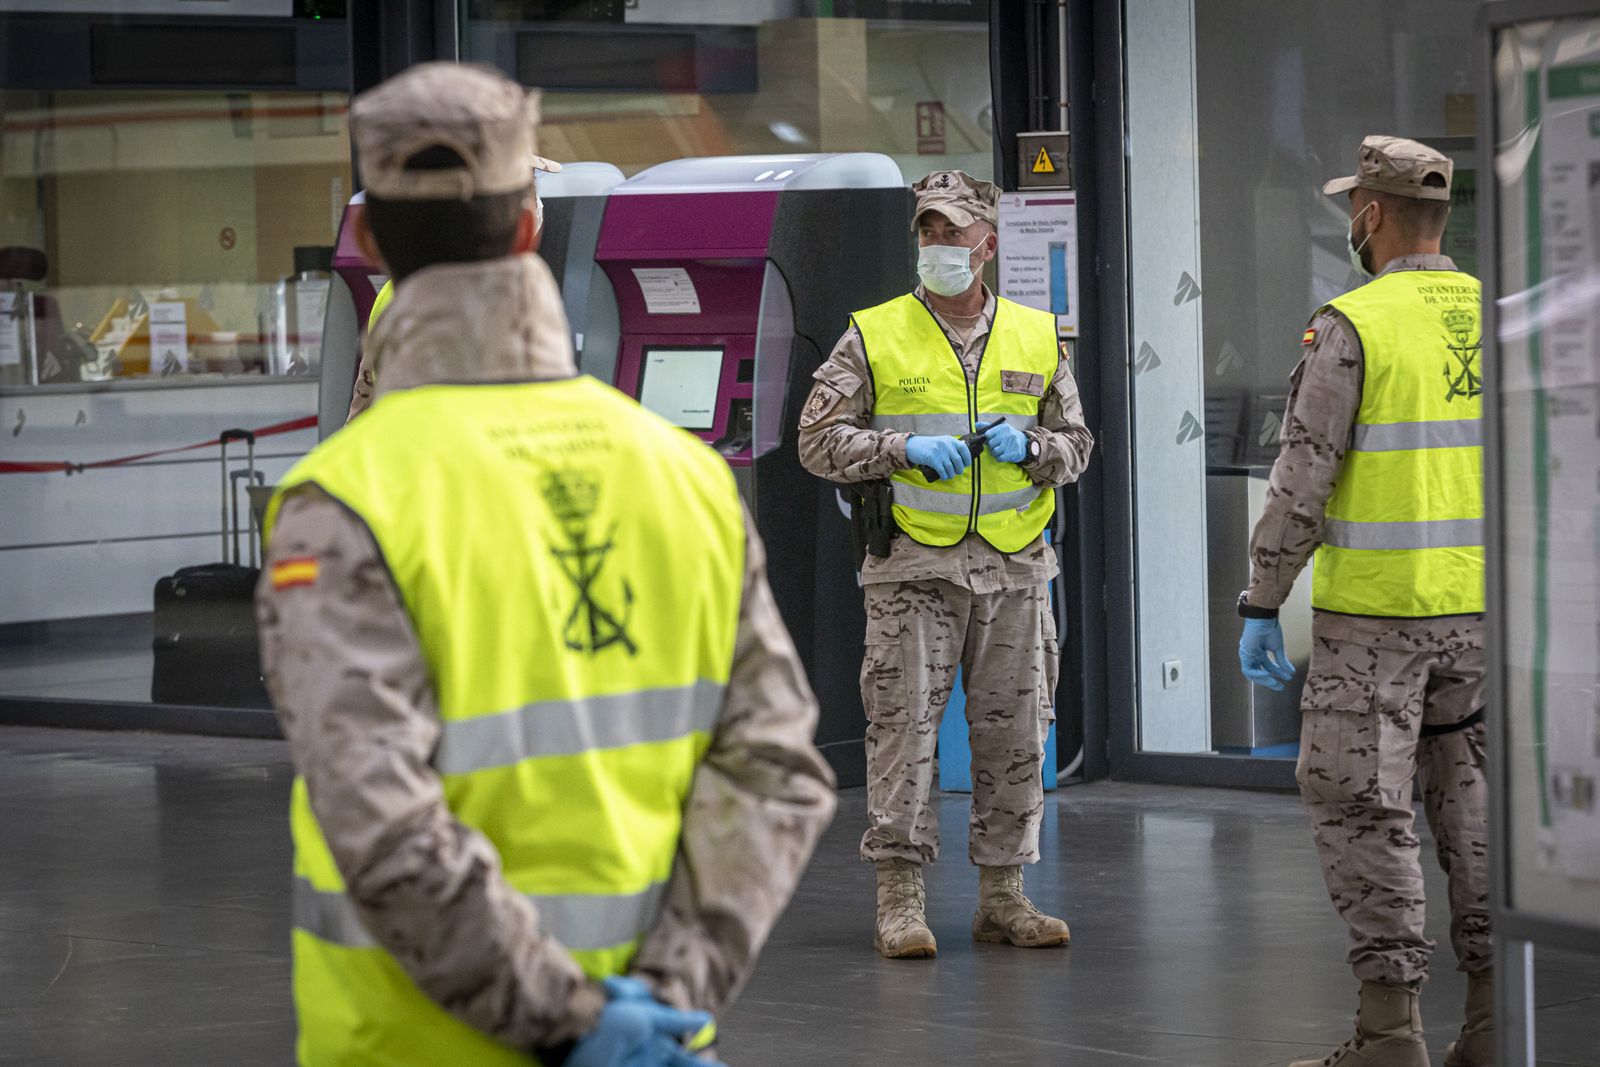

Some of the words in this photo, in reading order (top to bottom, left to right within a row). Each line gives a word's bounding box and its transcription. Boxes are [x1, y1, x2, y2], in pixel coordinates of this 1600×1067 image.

[1417, 286, 1479, 294] INFANTERIA
[1424, 296, 1439, 304] DE
[1440, 296, 1481, 304] MARINA
[899, 377, 930, 386] POLICIA
[903, 385, 928, 394] NAVAL
